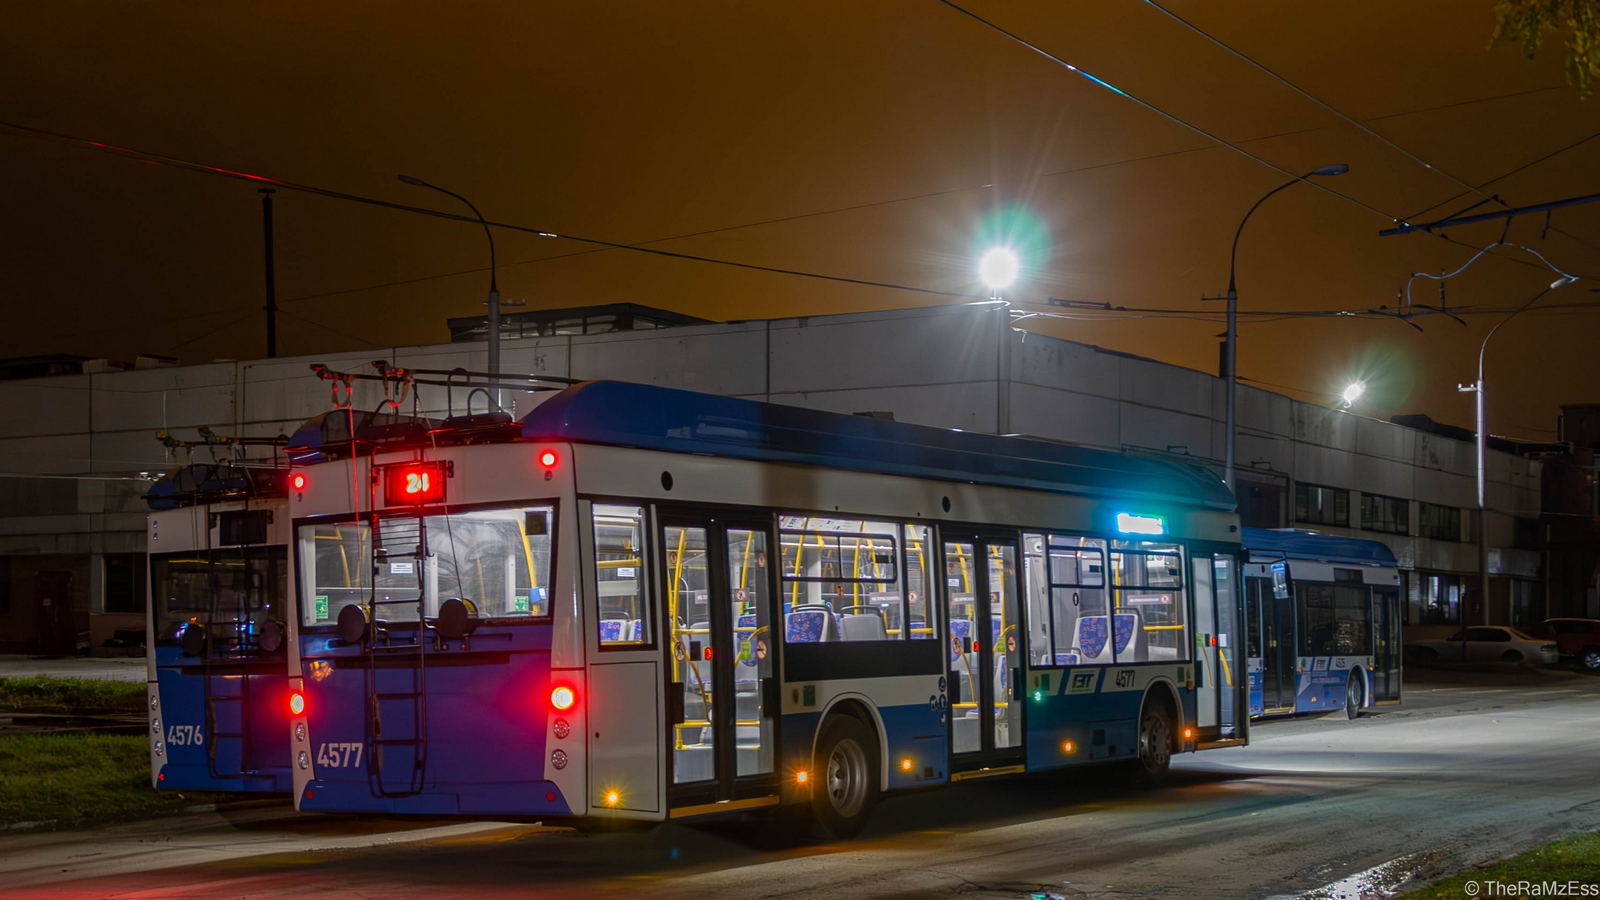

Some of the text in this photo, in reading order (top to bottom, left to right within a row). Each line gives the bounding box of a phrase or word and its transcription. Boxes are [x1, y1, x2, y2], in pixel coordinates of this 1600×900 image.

[1116, 670, 1135, 688] 4577
[167, 725, 204, 746] 4576
[317, 743, 363, 768] 4577
